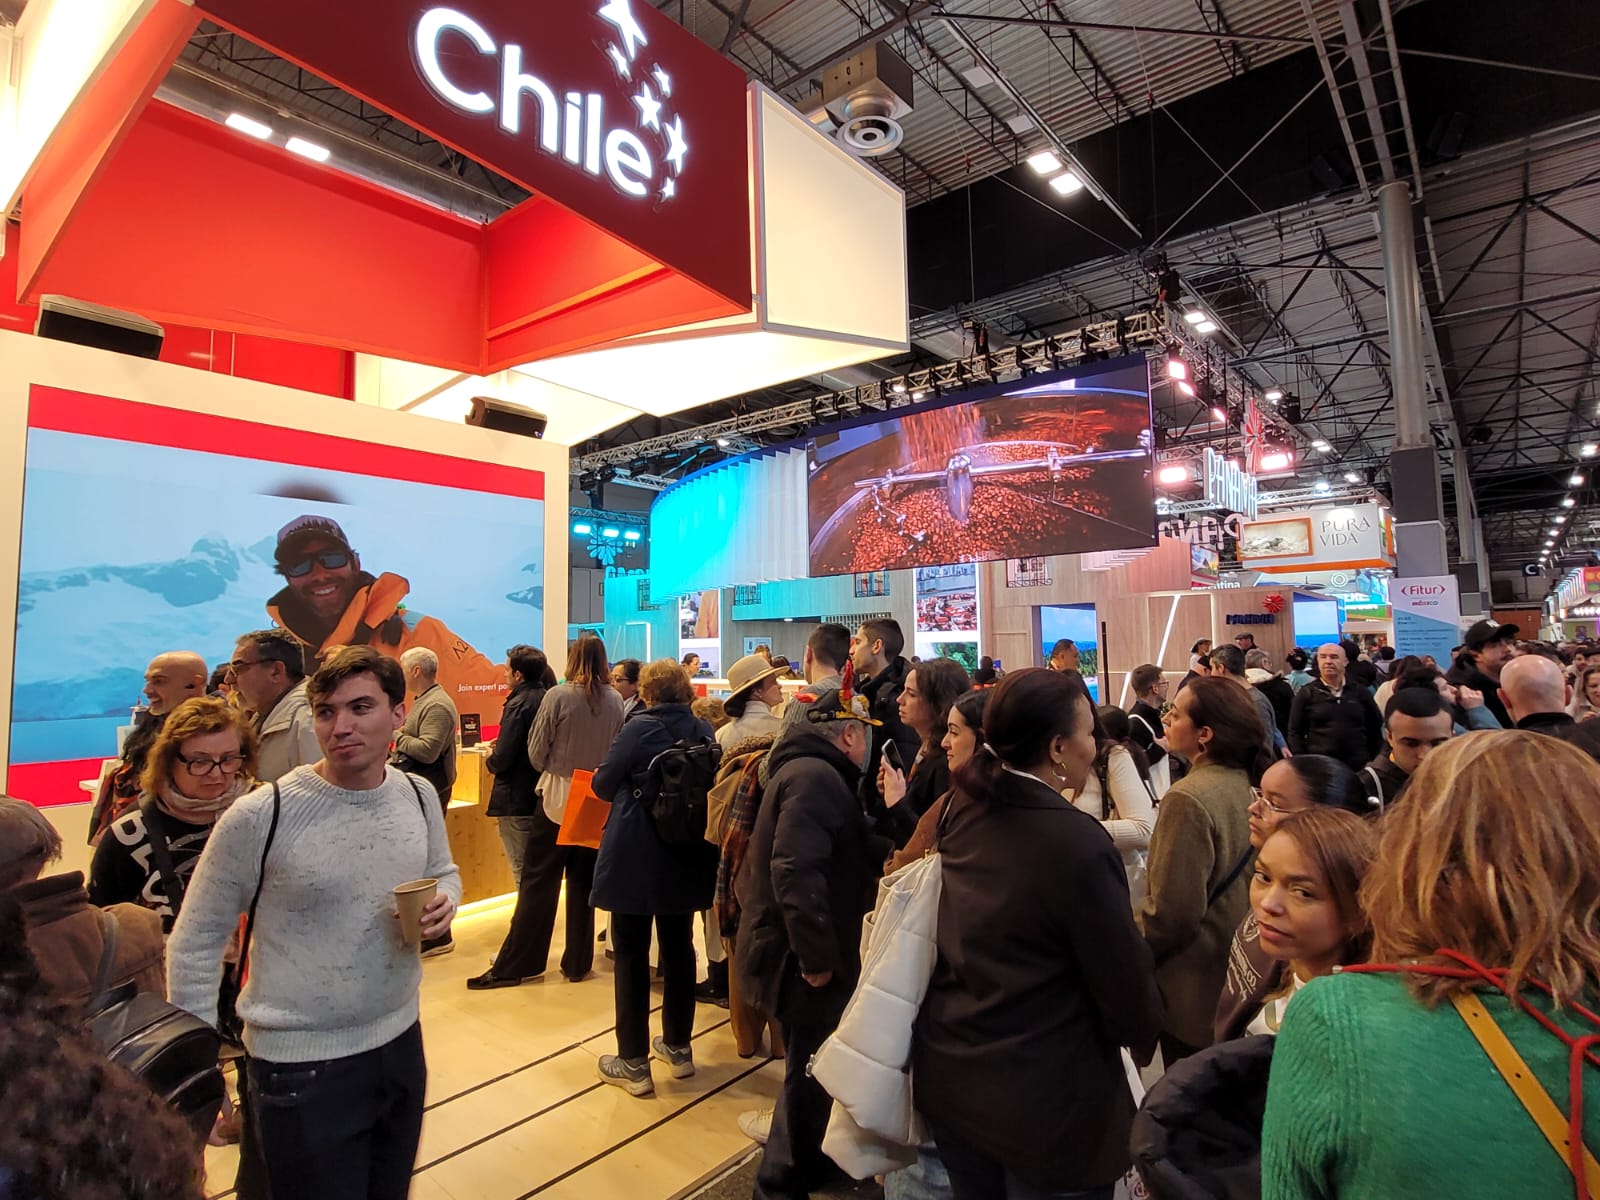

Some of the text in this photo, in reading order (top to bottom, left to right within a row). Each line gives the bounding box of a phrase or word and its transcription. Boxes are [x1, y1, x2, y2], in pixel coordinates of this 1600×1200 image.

[414, 7, 653, 196] Chile
[1321, 516, 1371, 533] PURA
[1320, 532, 1359, 547] VIDA
[1525, 563, 1537, 575] C
[1409, 585, 1438, 595] Fitur
[457, 683, 473, 693] Join
[474, 683, 497, 692] expert
